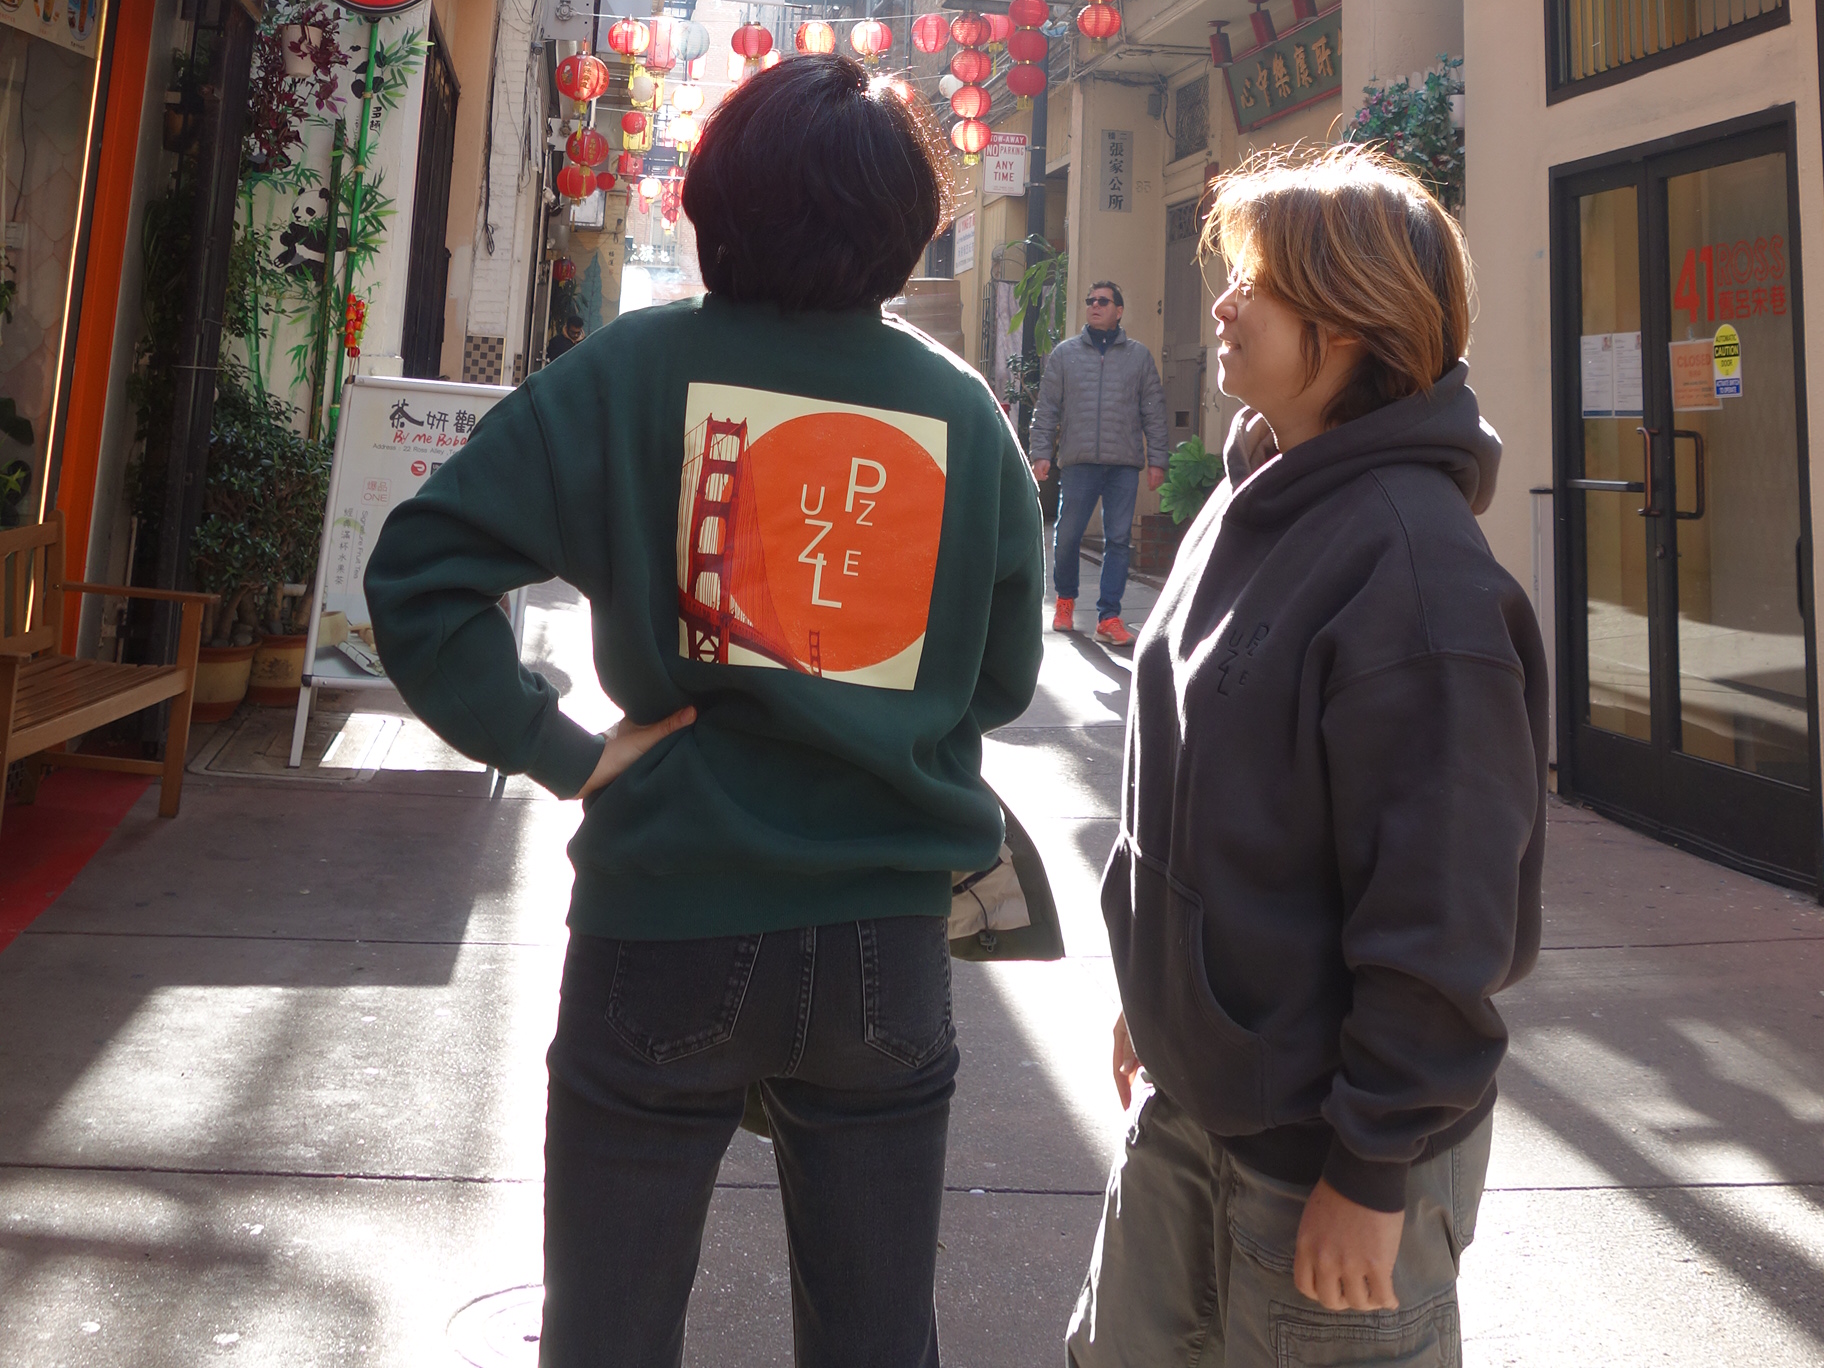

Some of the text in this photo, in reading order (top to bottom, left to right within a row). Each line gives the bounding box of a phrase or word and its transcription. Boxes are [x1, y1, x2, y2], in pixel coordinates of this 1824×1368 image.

[986, 144, 1024, 157] NO PARKING
[995, 160, 1014, 170] ANY
[993, 172, 1015, 182] TIME
[1108, 142, 1124, 210] 張家公所
[1674, 234, 1786, 323] 41 ROSS
[1718, 284, 1787, 321] 舊呂宋巷
[1714, 345, 1739, 357] CAUTION
[1677, 355, 1711, 368] CLOSED
[1721, 359, 1733, 367] DOOR
[393, 430, 468, 447] By Me Boba
[373, 443, 396, 451] Address
[364, 493, 388, 502] ONE
